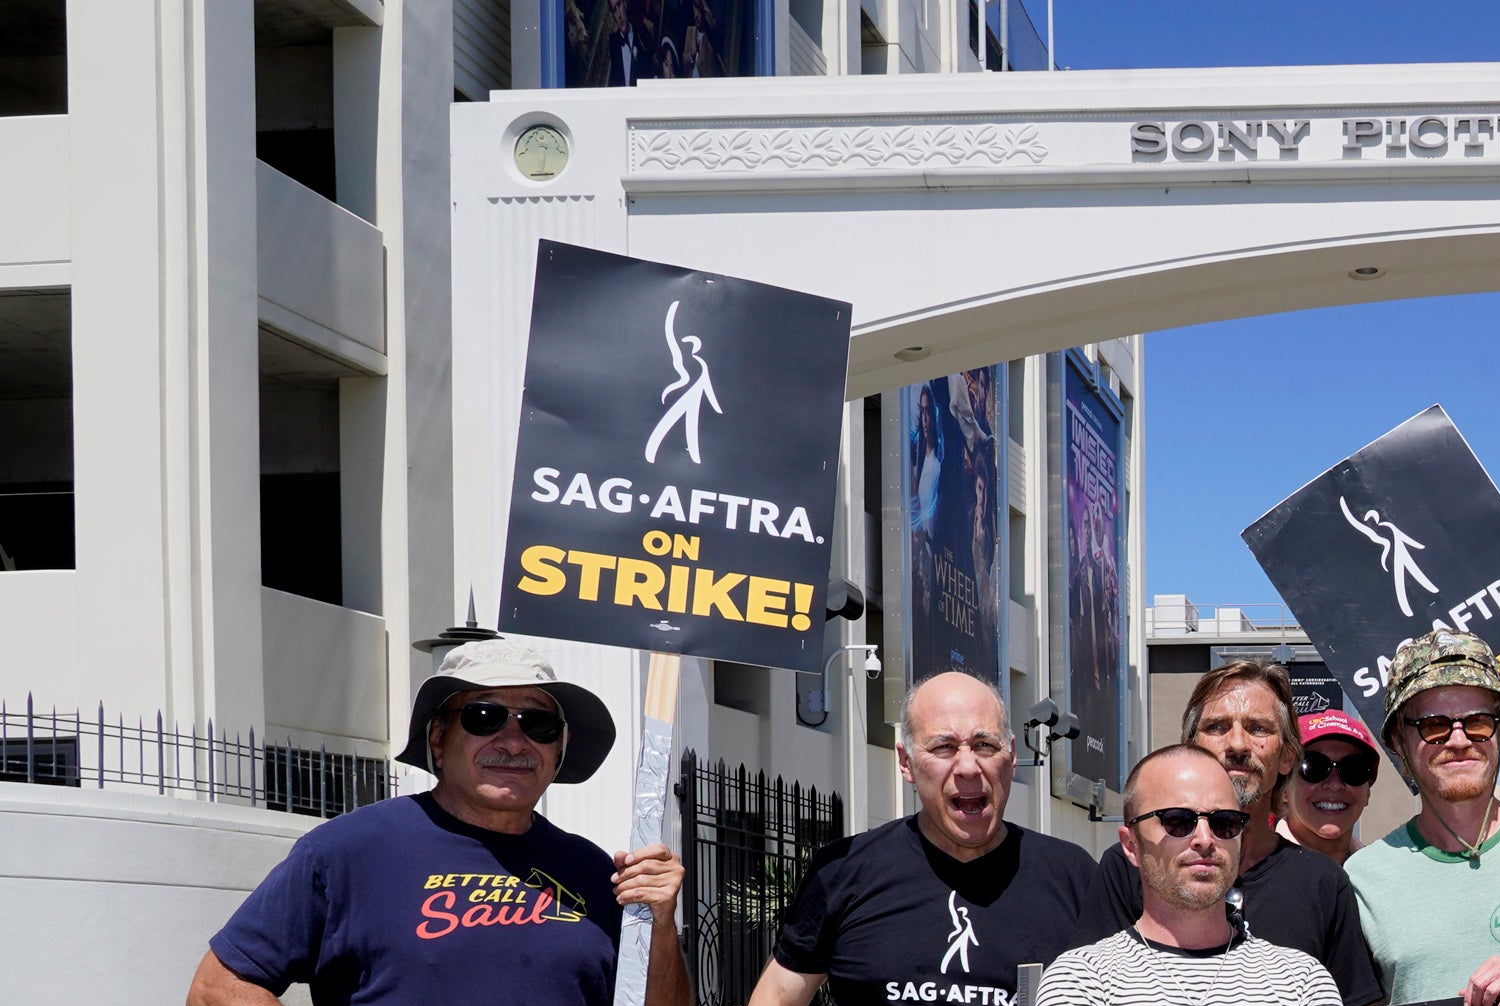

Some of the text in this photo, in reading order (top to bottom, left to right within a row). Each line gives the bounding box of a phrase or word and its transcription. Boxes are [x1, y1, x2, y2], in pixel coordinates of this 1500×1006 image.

[1130, 120, 1309, 155] SONY
[642, 530, 699, 561] ON
[517, 545, 815, 632] STRIKE!
[934, 553, 979, 610] WHEEL
[942, 590, 975, 638] TIME
[424, 873, 520, 890] BETTER
[469, 889, 526, 903] CALL
[416, 887, 555, 939] Saul
